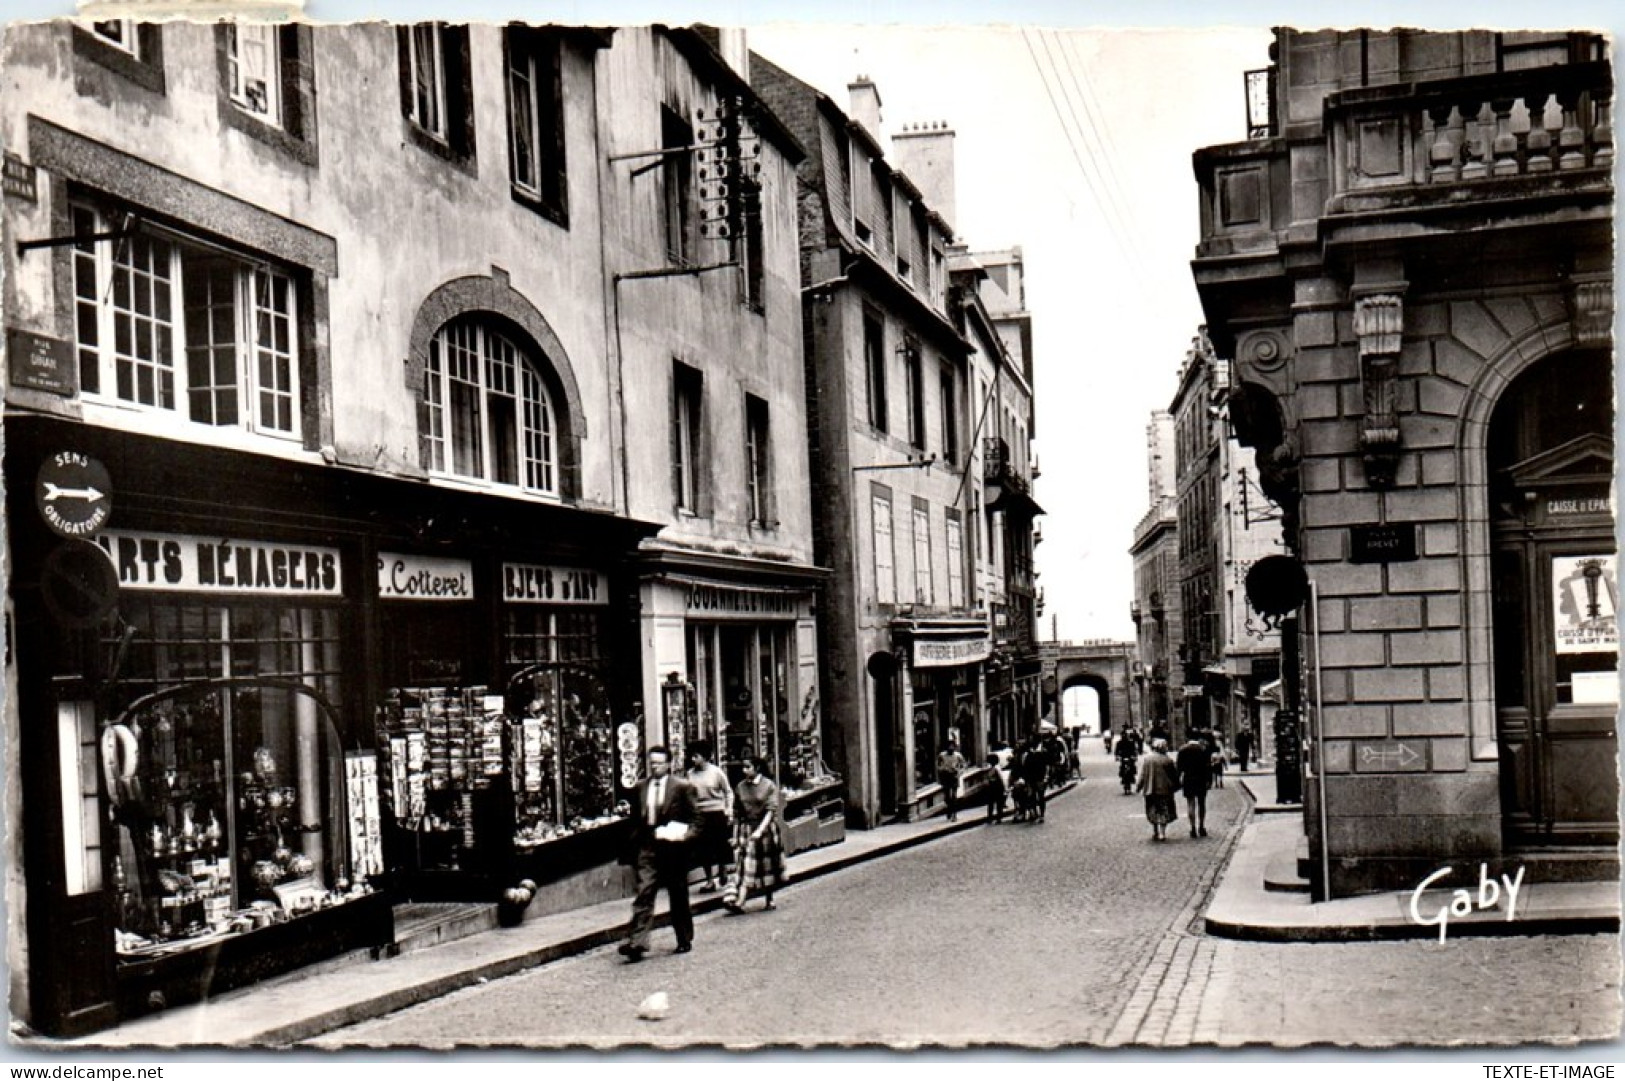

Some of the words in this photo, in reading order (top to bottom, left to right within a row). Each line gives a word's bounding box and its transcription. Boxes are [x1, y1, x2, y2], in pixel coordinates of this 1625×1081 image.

[55, 451, 88, 467] SENS
[1548, 500, 1578, 514] CAISSE
[45, 505, 105, 534] OBLIGATOIRE
[197, 539, 337, 591] MÉNAGERS
